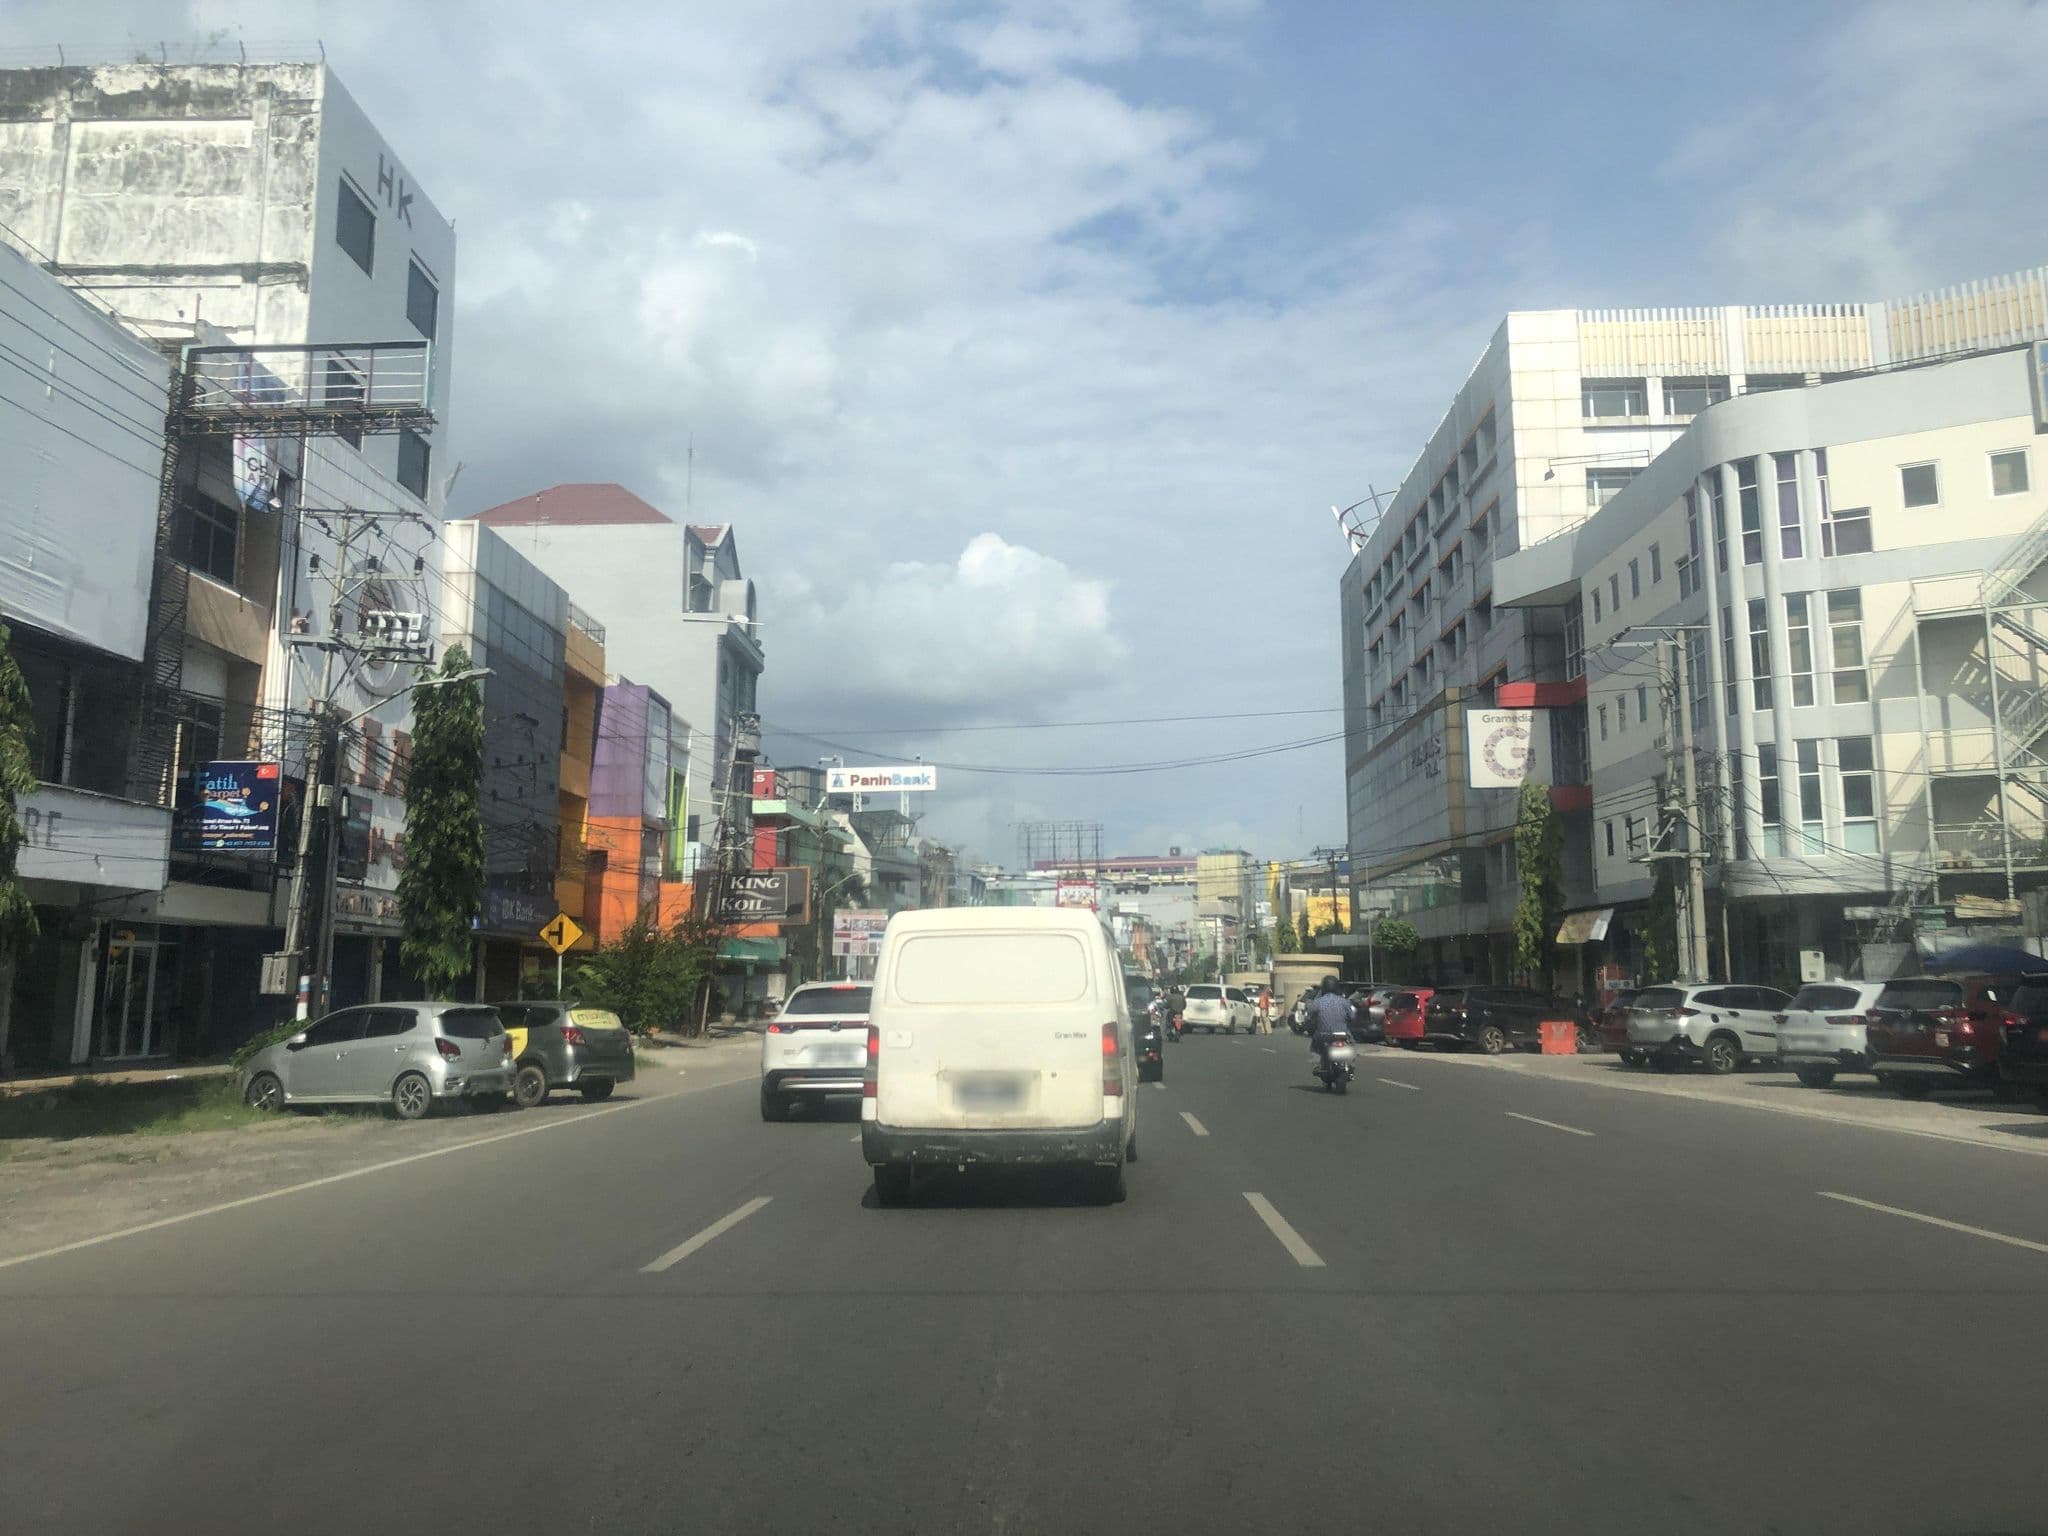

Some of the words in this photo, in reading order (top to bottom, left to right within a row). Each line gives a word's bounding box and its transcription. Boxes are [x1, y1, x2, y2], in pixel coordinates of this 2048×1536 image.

[1482, 714, 1534, 723] Gramedia
[850, 773, 931, 786] PaninBank
[730, 876, 780, 889] KING
